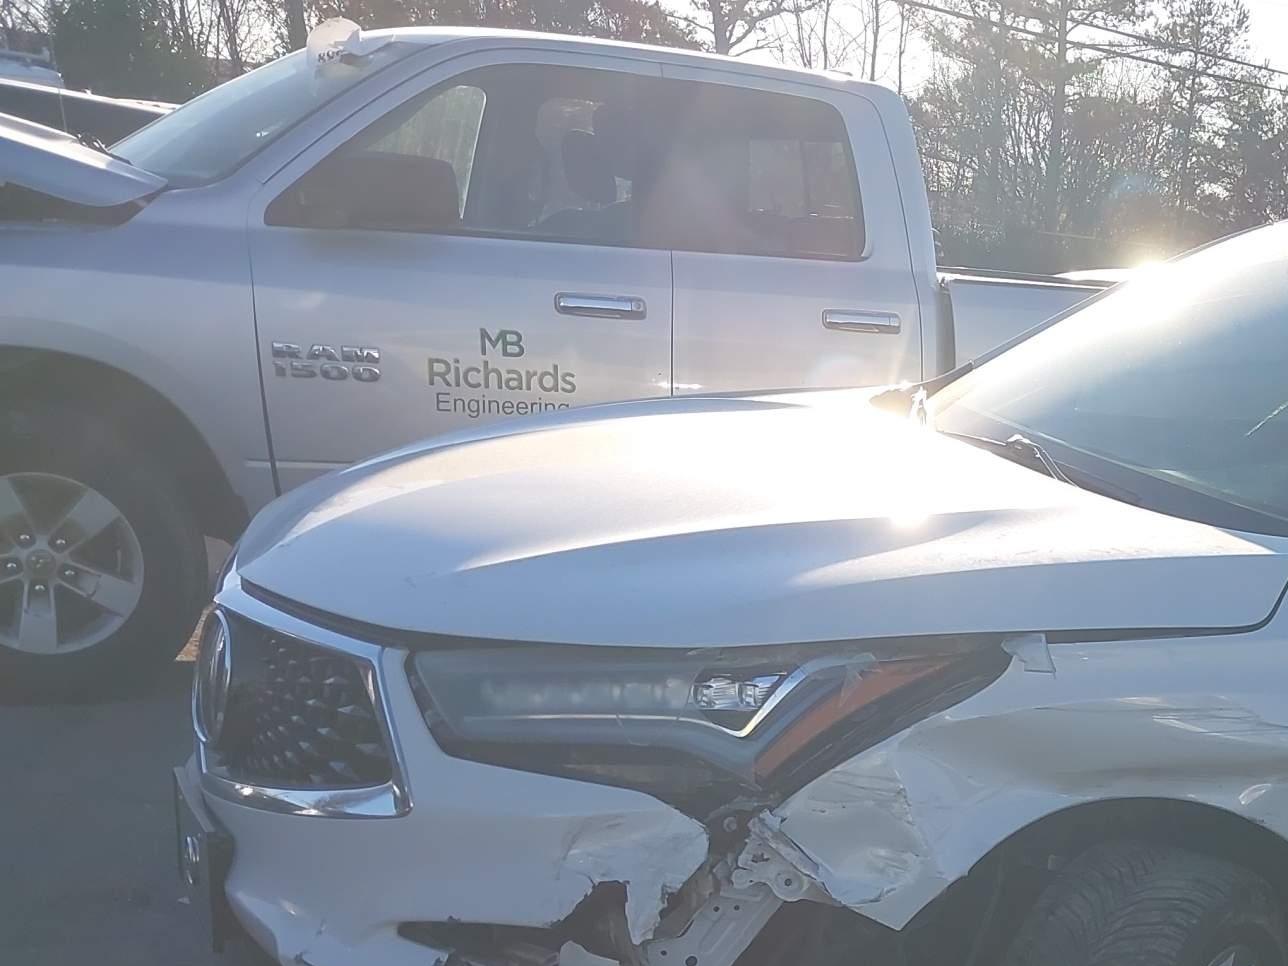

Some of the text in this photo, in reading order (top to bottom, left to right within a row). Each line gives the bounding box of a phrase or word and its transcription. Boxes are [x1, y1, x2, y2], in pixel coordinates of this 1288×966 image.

[271, 341, 380, 364] RAM
[479, 327, 525, 358] MB
[272, 361, 381, 383] 1500
[427, 357, 577, 394] Richards
